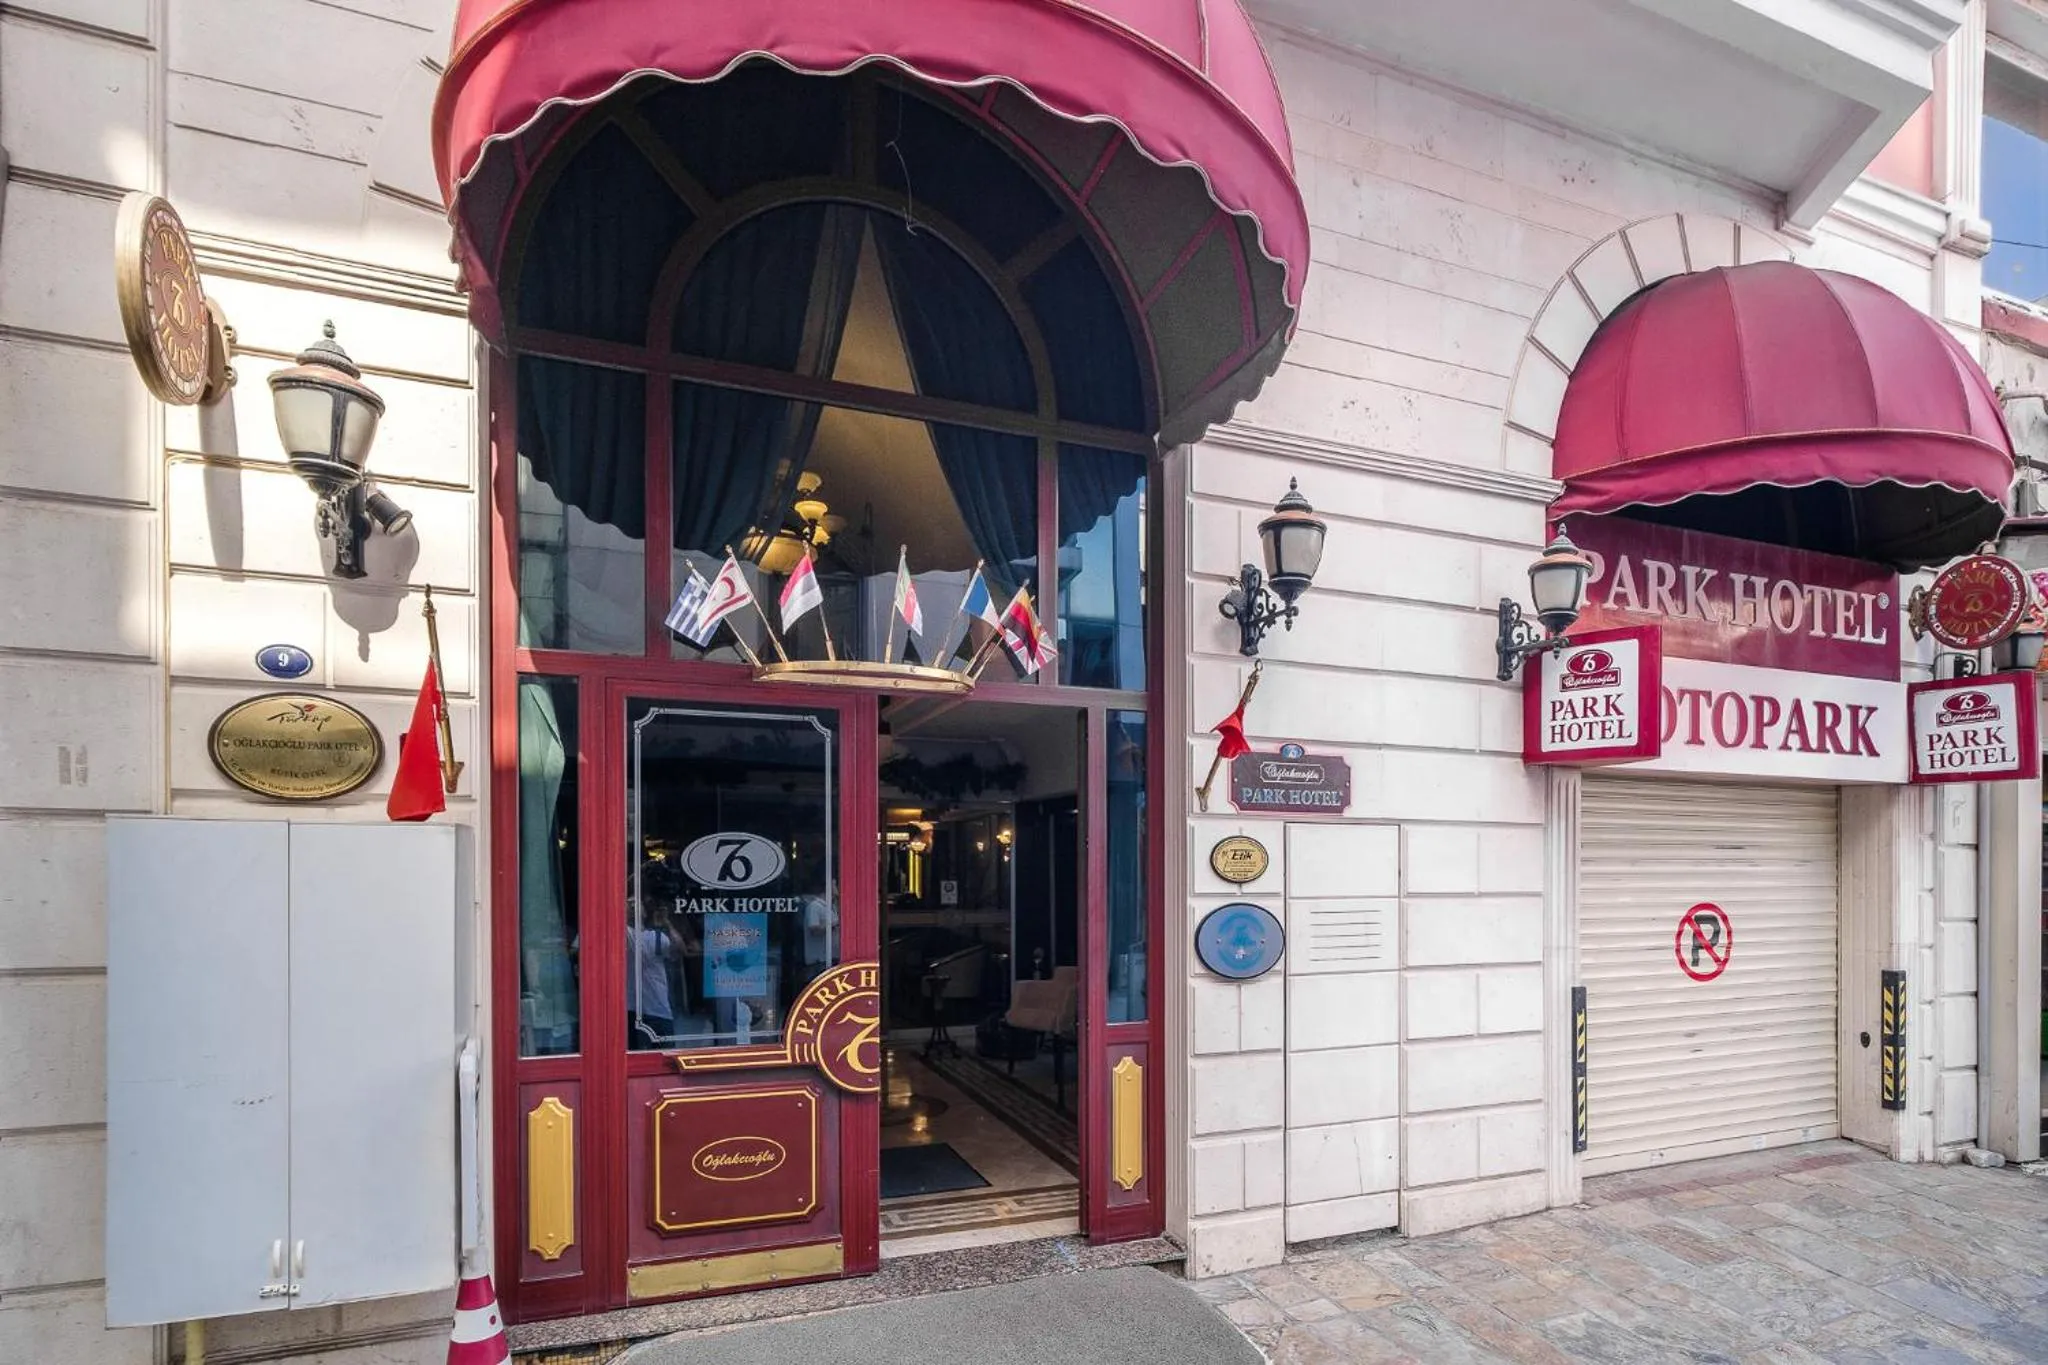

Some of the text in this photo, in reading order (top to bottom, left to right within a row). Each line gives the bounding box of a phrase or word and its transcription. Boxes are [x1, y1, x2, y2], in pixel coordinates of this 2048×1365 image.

[159, 232, 193, 291] PARK
[158, 312, 201, 373] HOTEL
[1953, 571, 1998, 591] PARK
[1578, 550, 1887, 646] PARK HOTEL
[278, 653, 289, 667] 9
[1550, 693, 1624, 721] PARK
[1550, 719, 1632, 743] HOTEL
[1927, 726, 2006, 751] PARK
[308, 741, 334, 751] PARK
[335, 742, 360, 752] OTEL
[1928, 747, 2016, 769] HOTEL
[1241, 787, 1341, 806] PARK HOTEL
[674, 897, 799, 914] PARK HOTEL
[796, 973, 857, 1036] PARK
